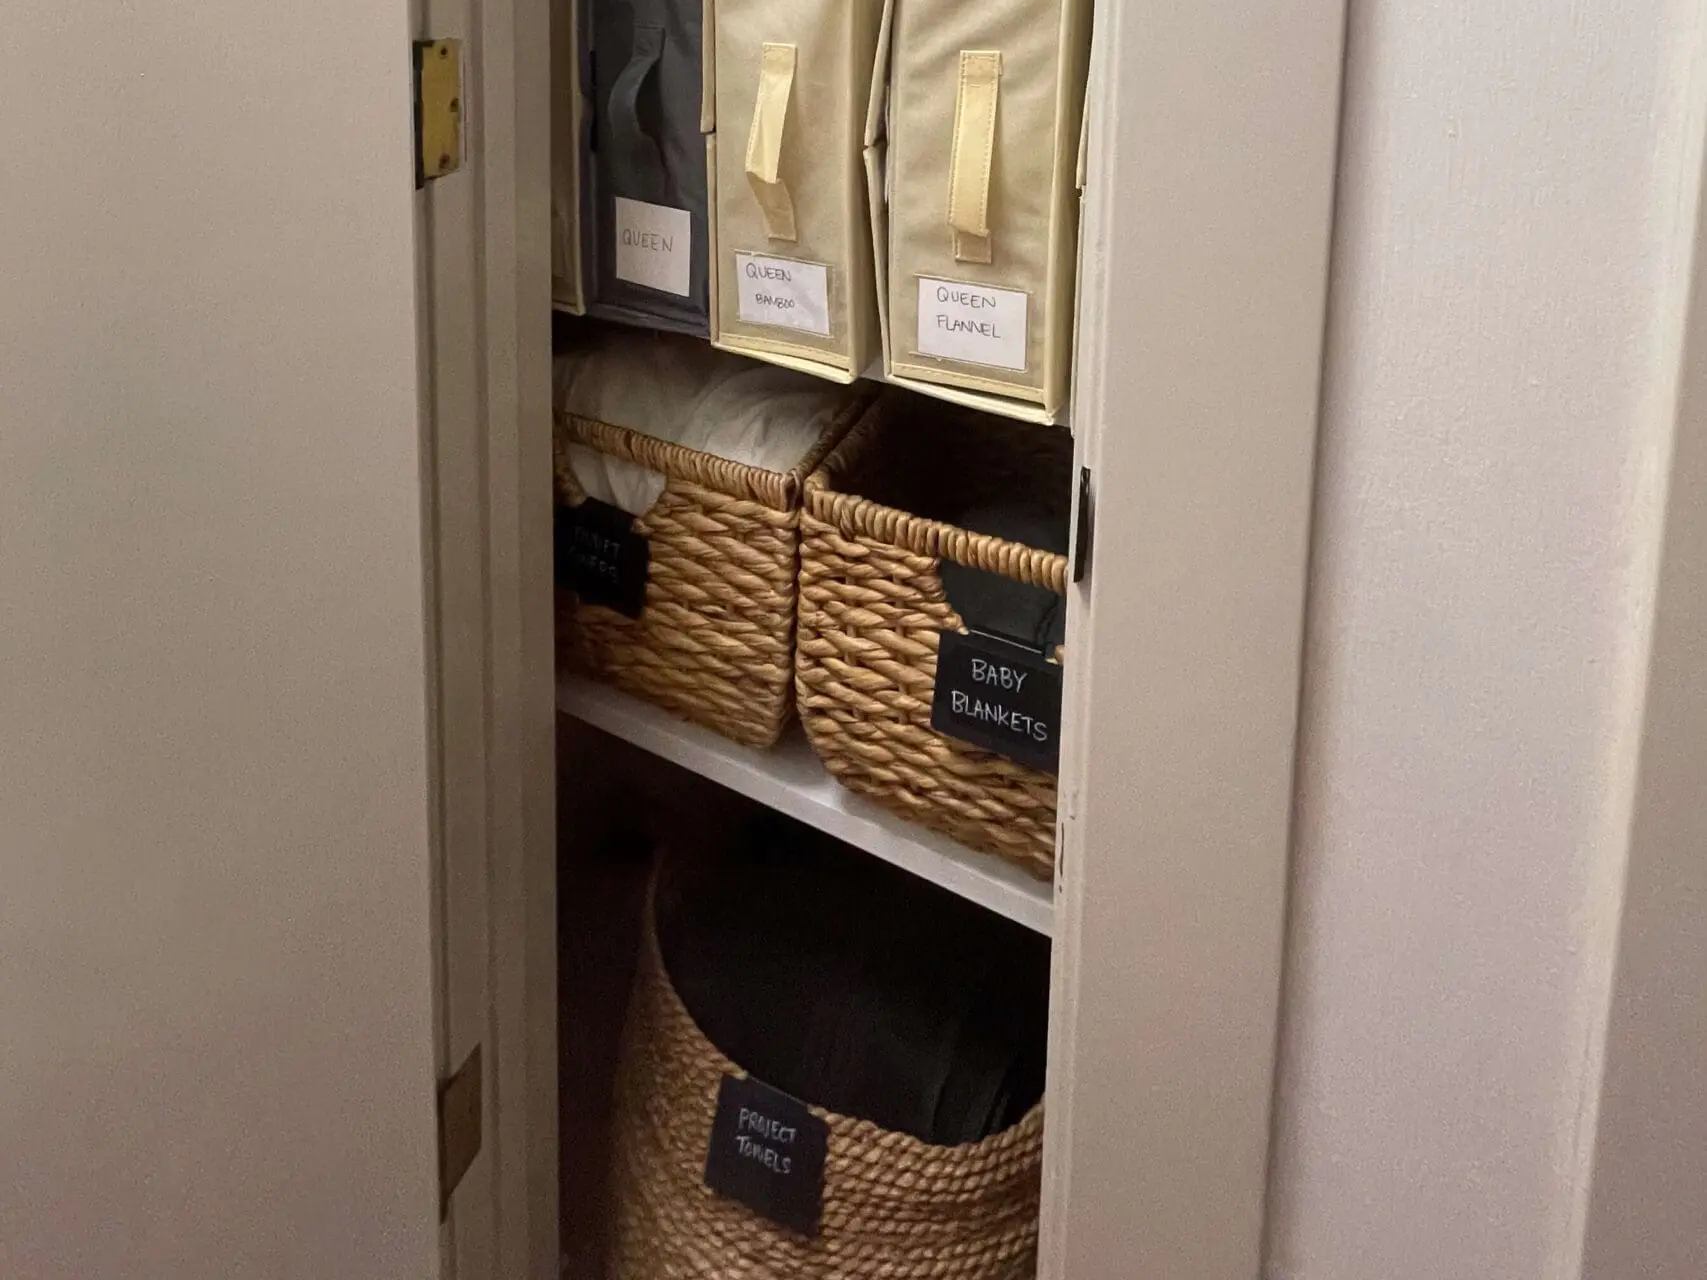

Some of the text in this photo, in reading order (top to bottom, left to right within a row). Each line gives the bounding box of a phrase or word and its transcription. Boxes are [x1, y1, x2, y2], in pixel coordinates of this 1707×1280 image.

[622, 228, 673, 252] QUEEN
[745, 262, 793, 282] QUEEN
[755, 293, 795, 309] BAMBOO
[937, 286, 996, 309] QUEEN
[936, 314, 1002, 338] FLANNEL
[972, 658, 1028, 693] BABY
[952, 690, 1048, 741] BLANKETS
[739, 1107, 797, 1142] PROJECT
[735, 1135, 792, 1174] TOWELS
